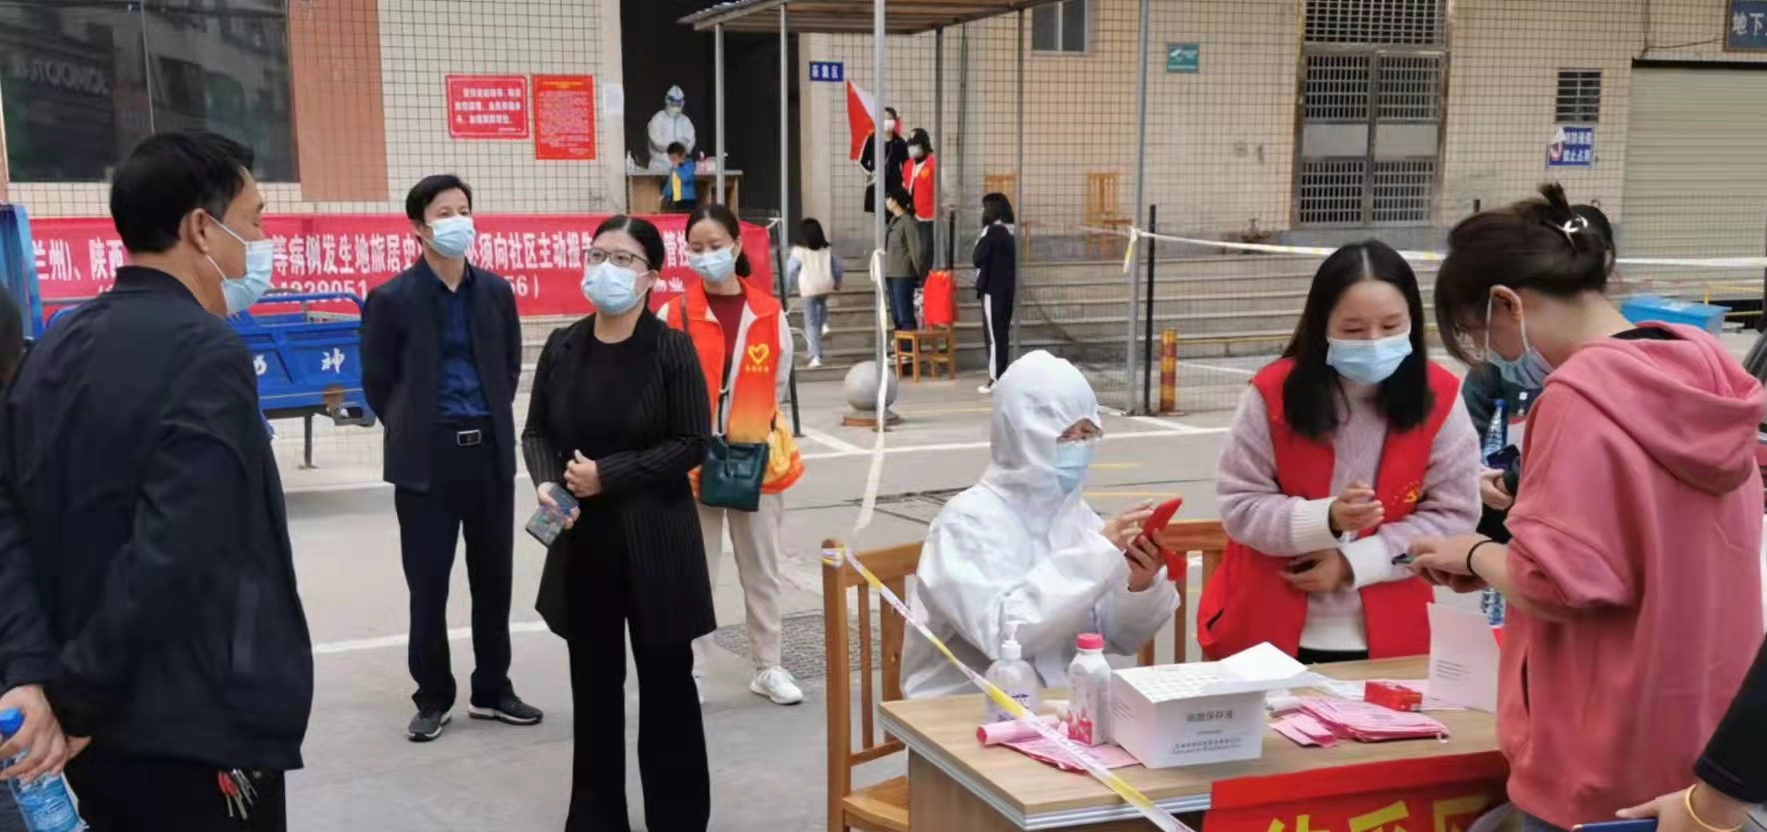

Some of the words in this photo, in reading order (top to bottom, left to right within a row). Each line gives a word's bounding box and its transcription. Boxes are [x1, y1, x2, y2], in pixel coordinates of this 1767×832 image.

[1732, 11, 1767, 36] 地下
[272, 233, 423, 276] 等病例发生地旅居史
[321, 347, 345, 374] 神
